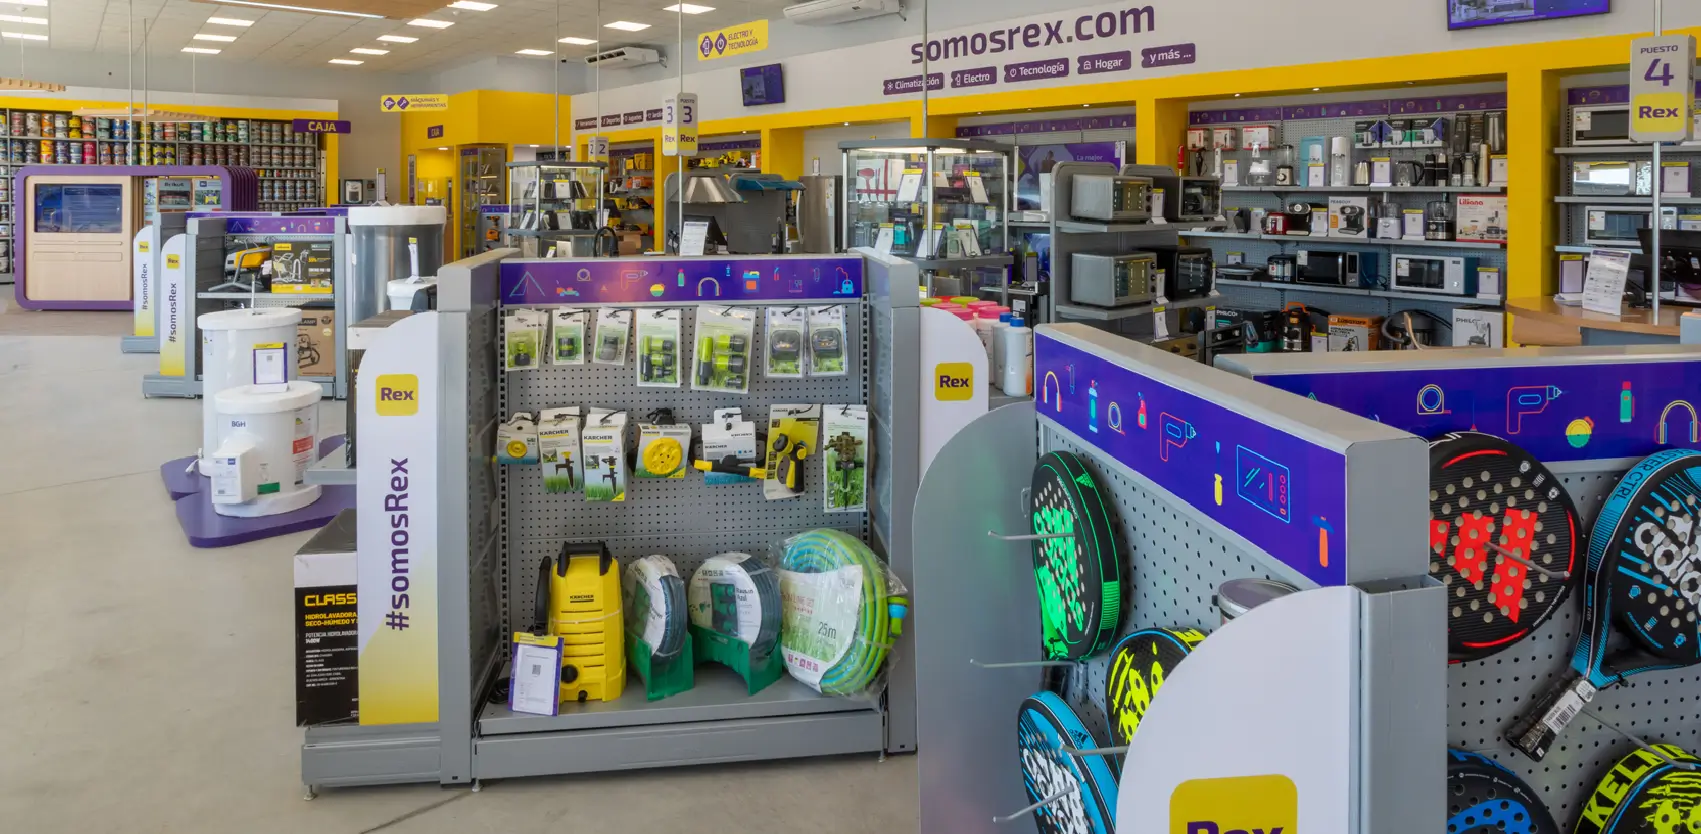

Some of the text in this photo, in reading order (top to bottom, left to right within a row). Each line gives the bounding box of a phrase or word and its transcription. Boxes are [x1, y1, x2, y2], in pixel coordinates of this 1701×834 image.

[728, 30, 749, 40] ELECTRO
[911, 5, 1155, 64] somosrex.com
[728, 37, 758, 50] TECNOLOGÍA
[1640, 45, 1679, 54] PUESTO
[1150, 53, 1157, 63] y
[1158, 49, 1181, 60] más
[1018, 61, 1065, 76] Tecnología
[1095, 57, 1123, 70] Hogar
[964, 72, 990, 83] Electro
[1643, 58, 1675, 87] 4
[667, 105, 674, 123] 3
[683, 105, 693, 123] 3
[1638, 105, 1679, 119] Rex
[308, 121, 337, 132] CAJA
[664, 134, 675, 143] Rex
[680, 134, 696, 143] Rex
[599, 143, 606, 155] 2
[168, 283, 177, 343] #somosRex
[939, 375, 969, 388] Rex
[380, 387, 414, 401] Rex
[231, 420, 246, 428] BGH
[1612, 471, 1644, 502] CTRL
[384, 457, 410, 631] #somosRex
